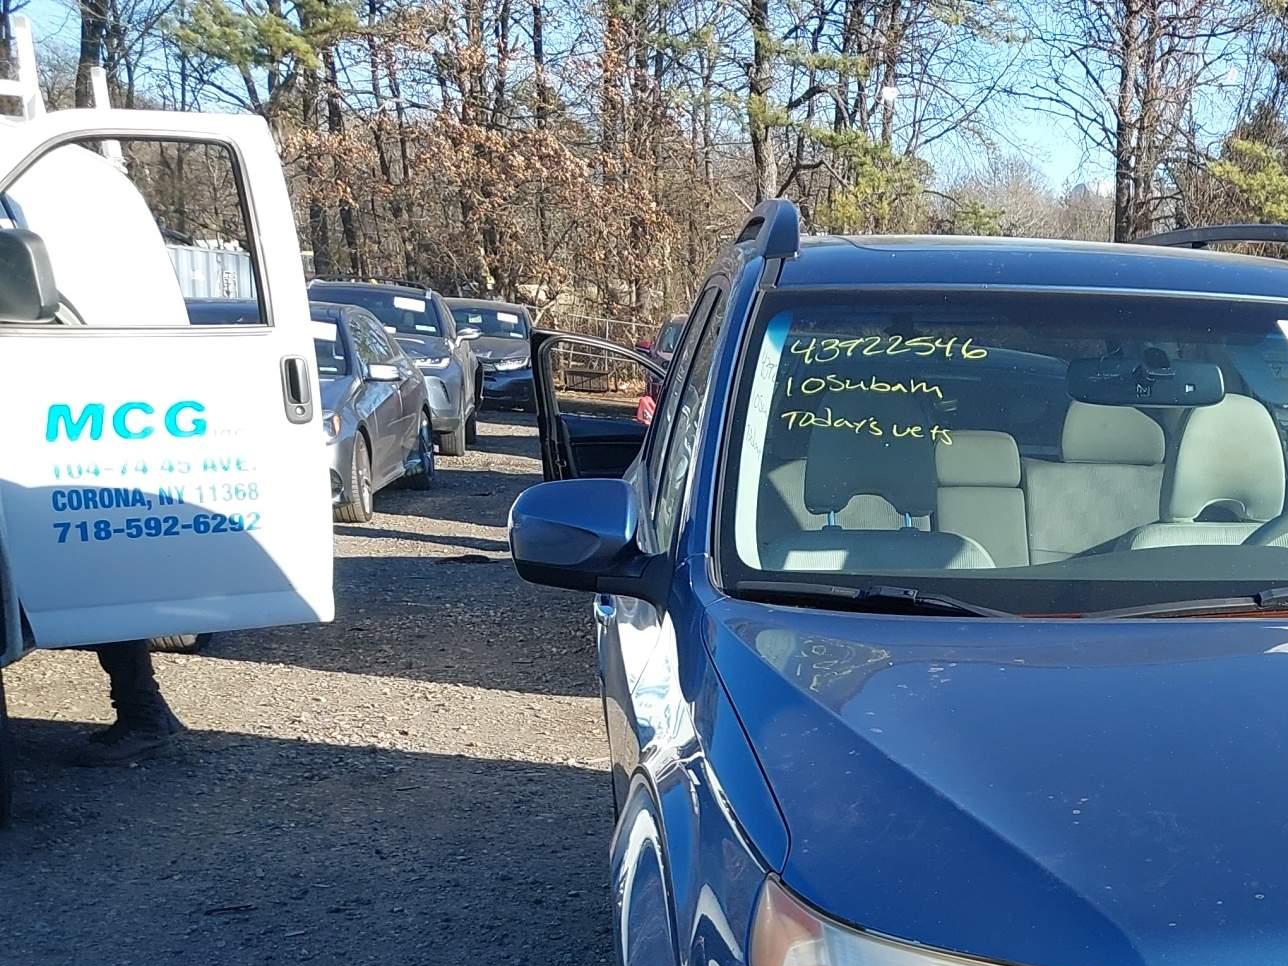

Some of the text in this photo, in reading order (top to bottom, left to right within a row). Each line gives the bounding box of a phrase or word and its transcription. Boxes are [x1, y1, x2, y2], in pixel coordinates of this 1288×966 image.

[790, 335, 988, 364] 43922546
[45, 400, 208, 443] MCG
[51, 482, 259, 512] CORONA, NY 11368
[52, 511, 262, 544] 718-592-6292
